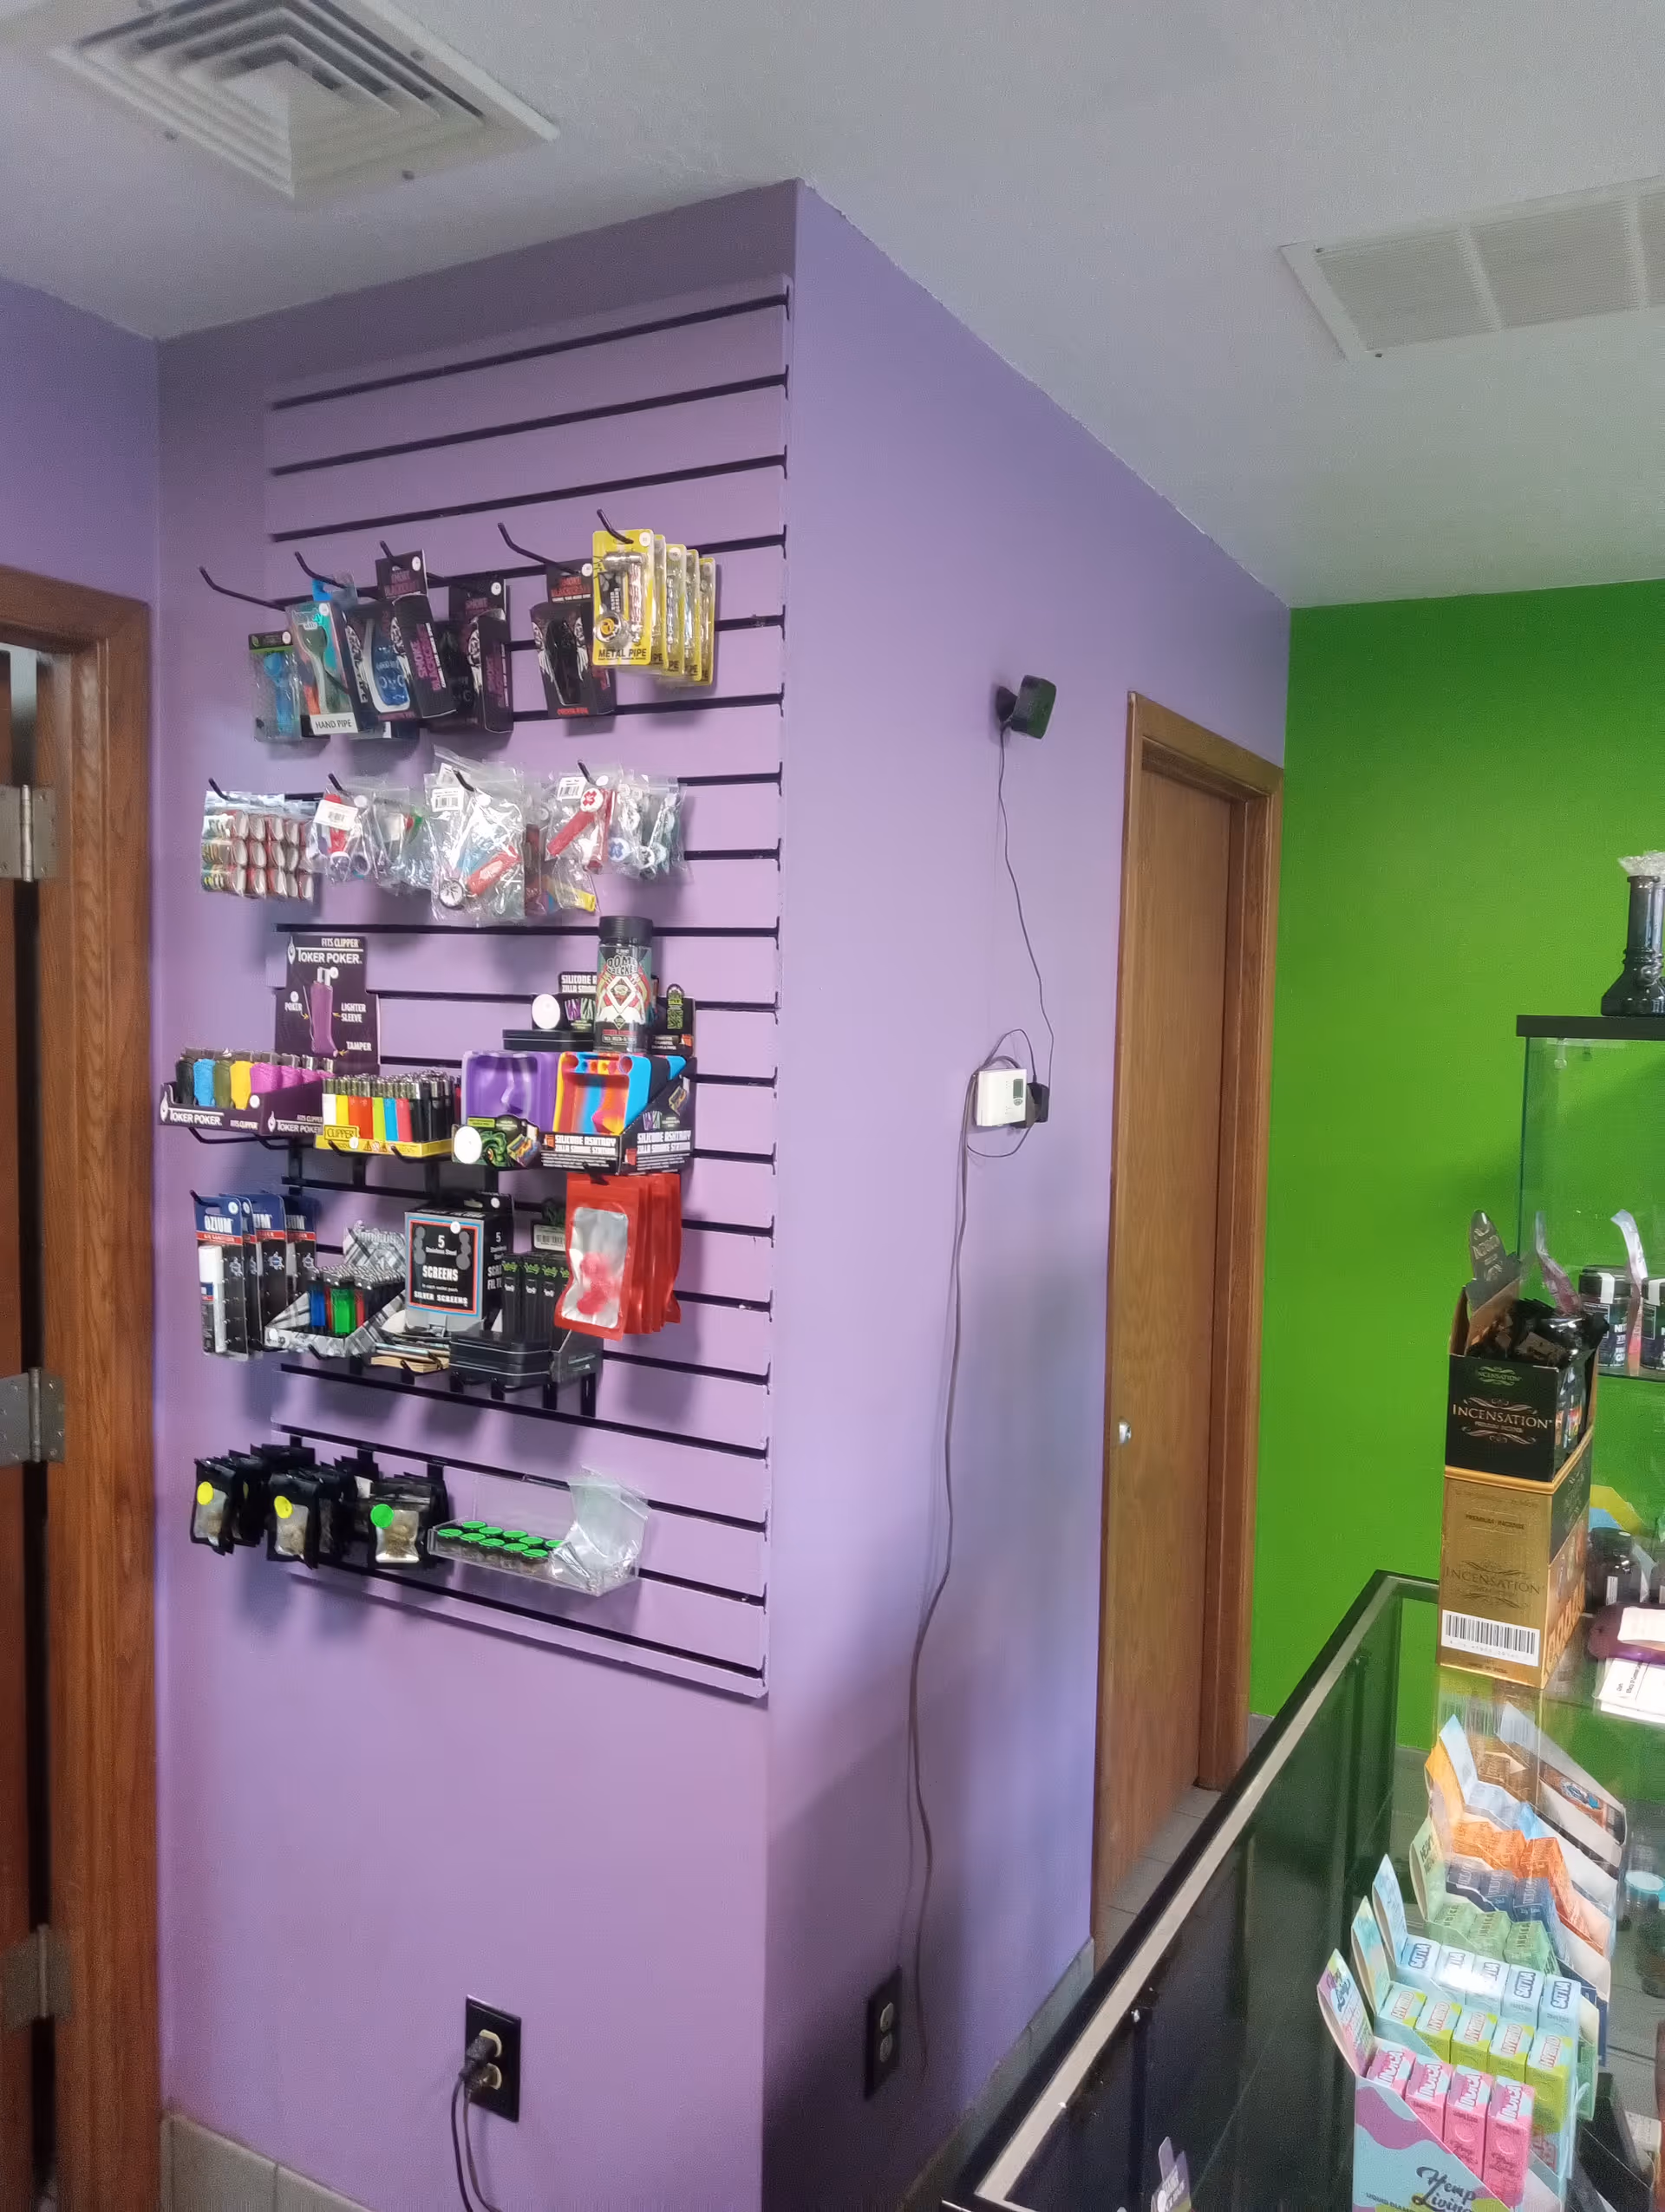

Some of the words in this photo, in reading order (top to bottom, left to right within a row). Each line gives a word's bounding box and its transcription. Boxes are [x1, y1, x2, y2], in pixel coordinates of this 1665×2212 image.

[597, 649, 626, 658] METAL
[628, 649, 647, 657] PIPE
[315, 720, 336, 729] HAND
[336, 719, 353, 728] PIPE
[321, 937, 334, 948] FITS
[334, 938, 359, 949] CLIPPER
[297, 949, 325, 963] TOKER
[326, 953, 361, 964] POKER
[341, 1002, 366, 1013] LIGHTER
[341, 1013, 362, 1023] SLEEVE
[346, 1041, 372, 1052] TAMPER
[169, 1109, 193, 1125] TOKER
[193, 1114, 222, 1126] POKER
[277, 1119, 299, 1132] TOKER
[326, 1127, 355, 1139] CLIPPER
[205, 1215, 232, 1235] OZIUM
[437, 1234, 446, 1248] 5
[495, 1231, 502, 1243] 5
[421, 1264, 459, 1282] SCREENS
[414, 1290, 434, 1301] SILVER
[436, 1293, 468, 1305] SCREENS
[1453, 1404, 1549, 1429] INCENSATION
[1445, 1565, 1540, 1595] INCENSATION
[1514, 1970, 1536, 1999] SATIVA
[1551, 1980, 1571, 2010] SATIVA
[1391, 1990, 1415, 2020] HYBRID
[1501, 2023, 1524, 2054] HYBRID
[1416, 2166, 1475, 2205] Hemp
